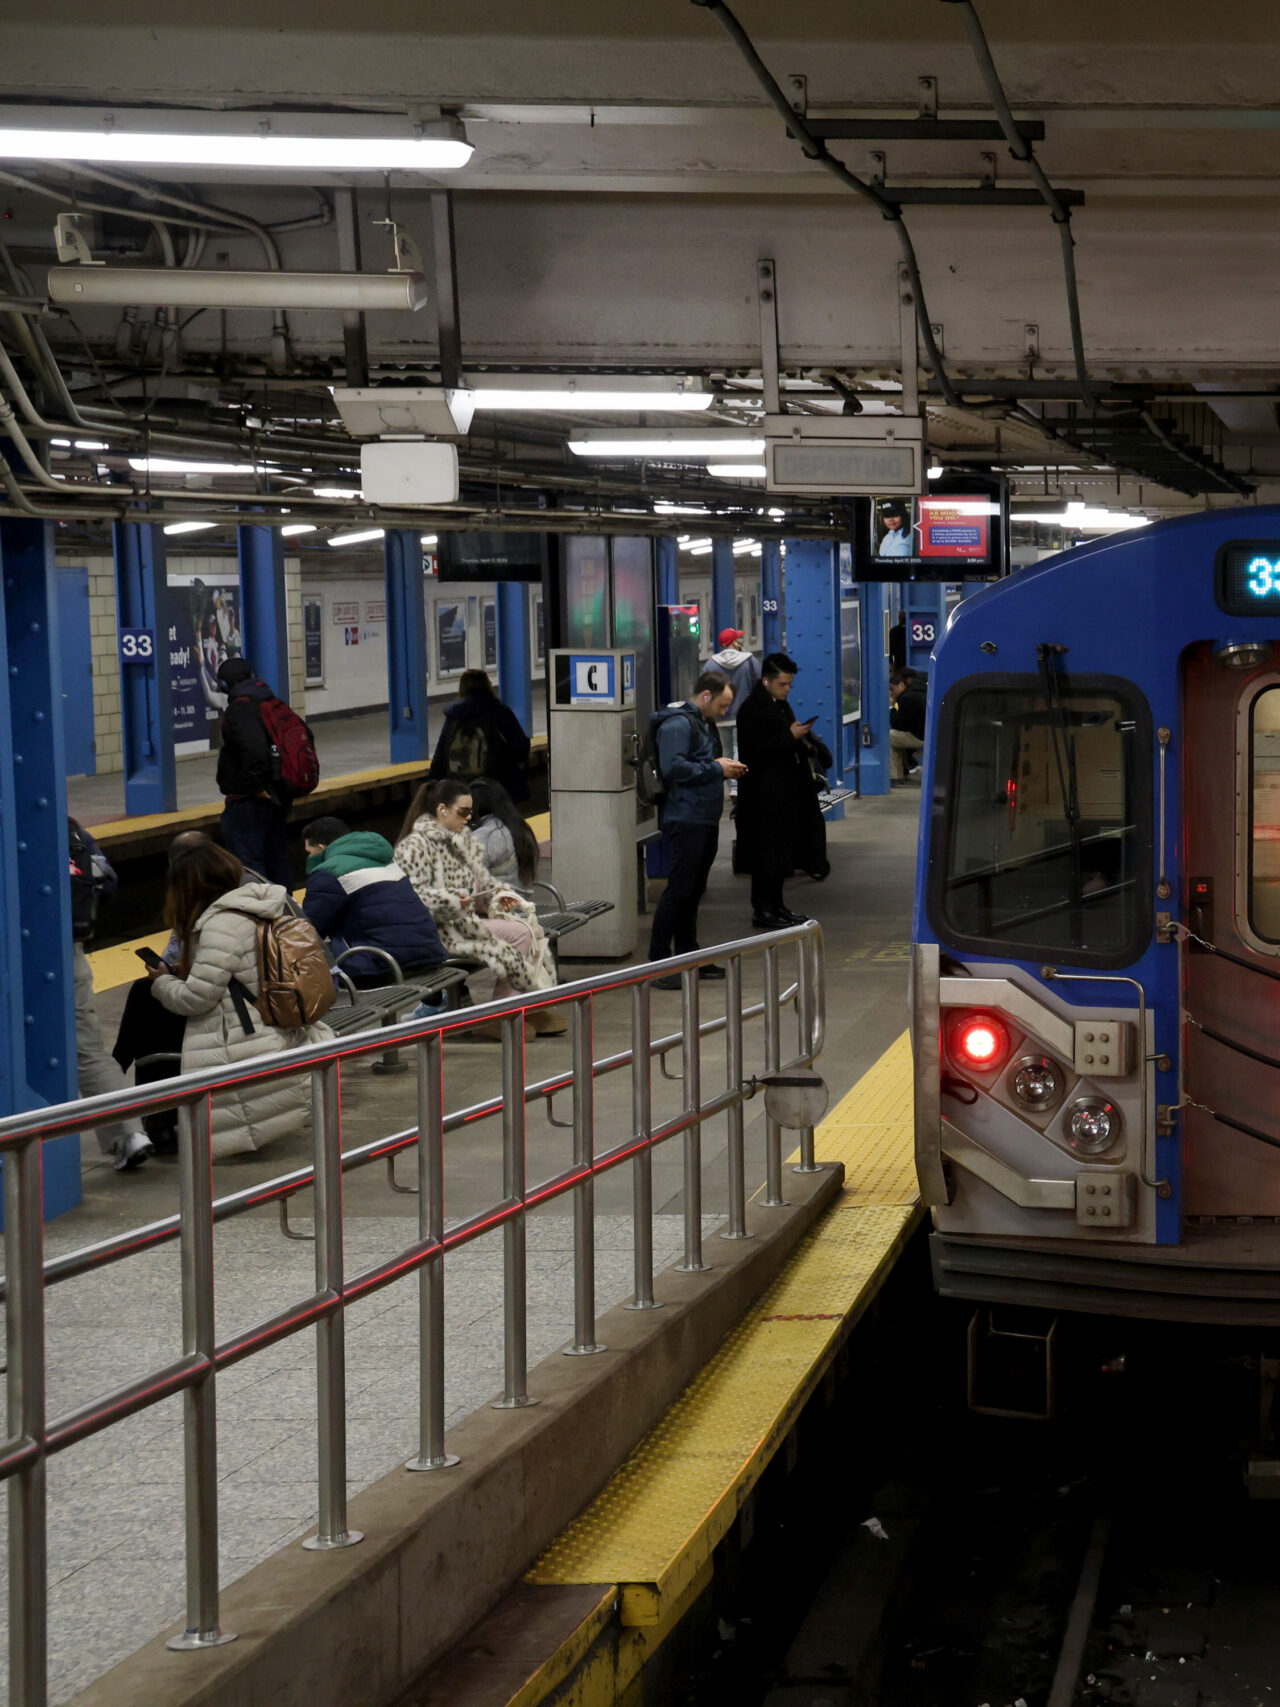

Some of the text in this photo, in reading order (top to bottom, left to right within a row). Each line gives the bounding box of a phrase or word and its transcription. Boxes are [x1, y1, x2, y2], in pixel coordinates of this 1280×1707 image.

[783, 453, 903, 477] DEPARTING
[763, 600, 778, 611] 33
[912, 624, 935, 642] 33
[122, 634, 152, 656] 33
